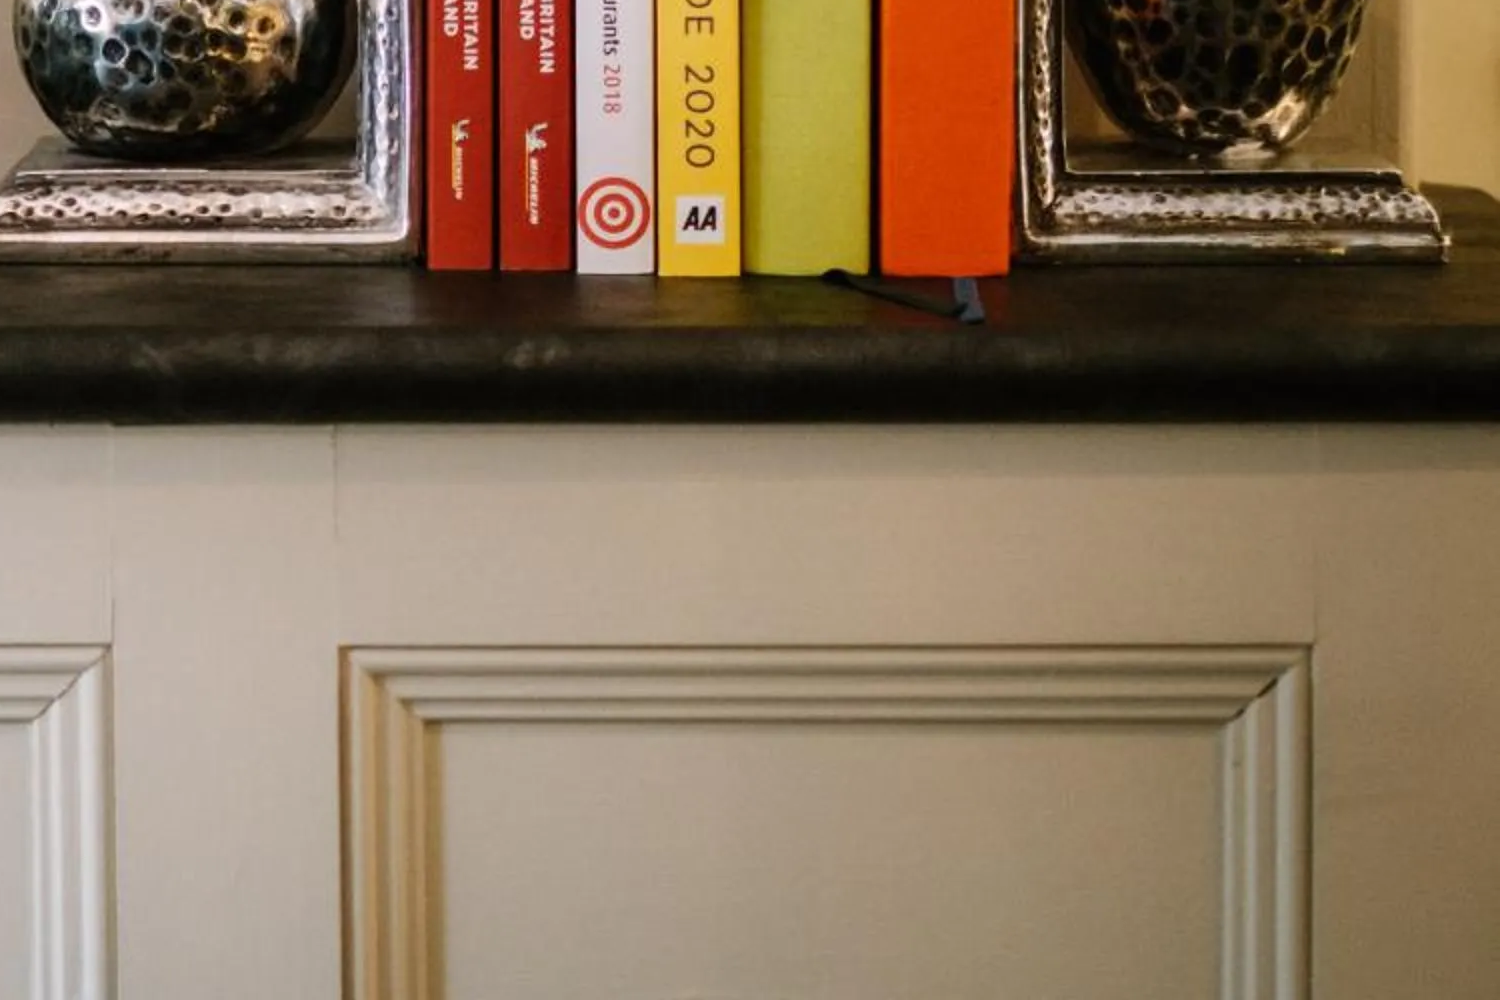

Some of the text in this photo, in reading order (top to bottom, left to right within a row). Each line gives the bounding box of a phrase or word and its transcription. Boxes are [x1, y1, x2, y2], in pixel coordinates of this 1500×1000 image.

[602, 64, 623, 114] 2018
[684, 64, 715, 169] 2020
[682, 205, 717, 231] AA
